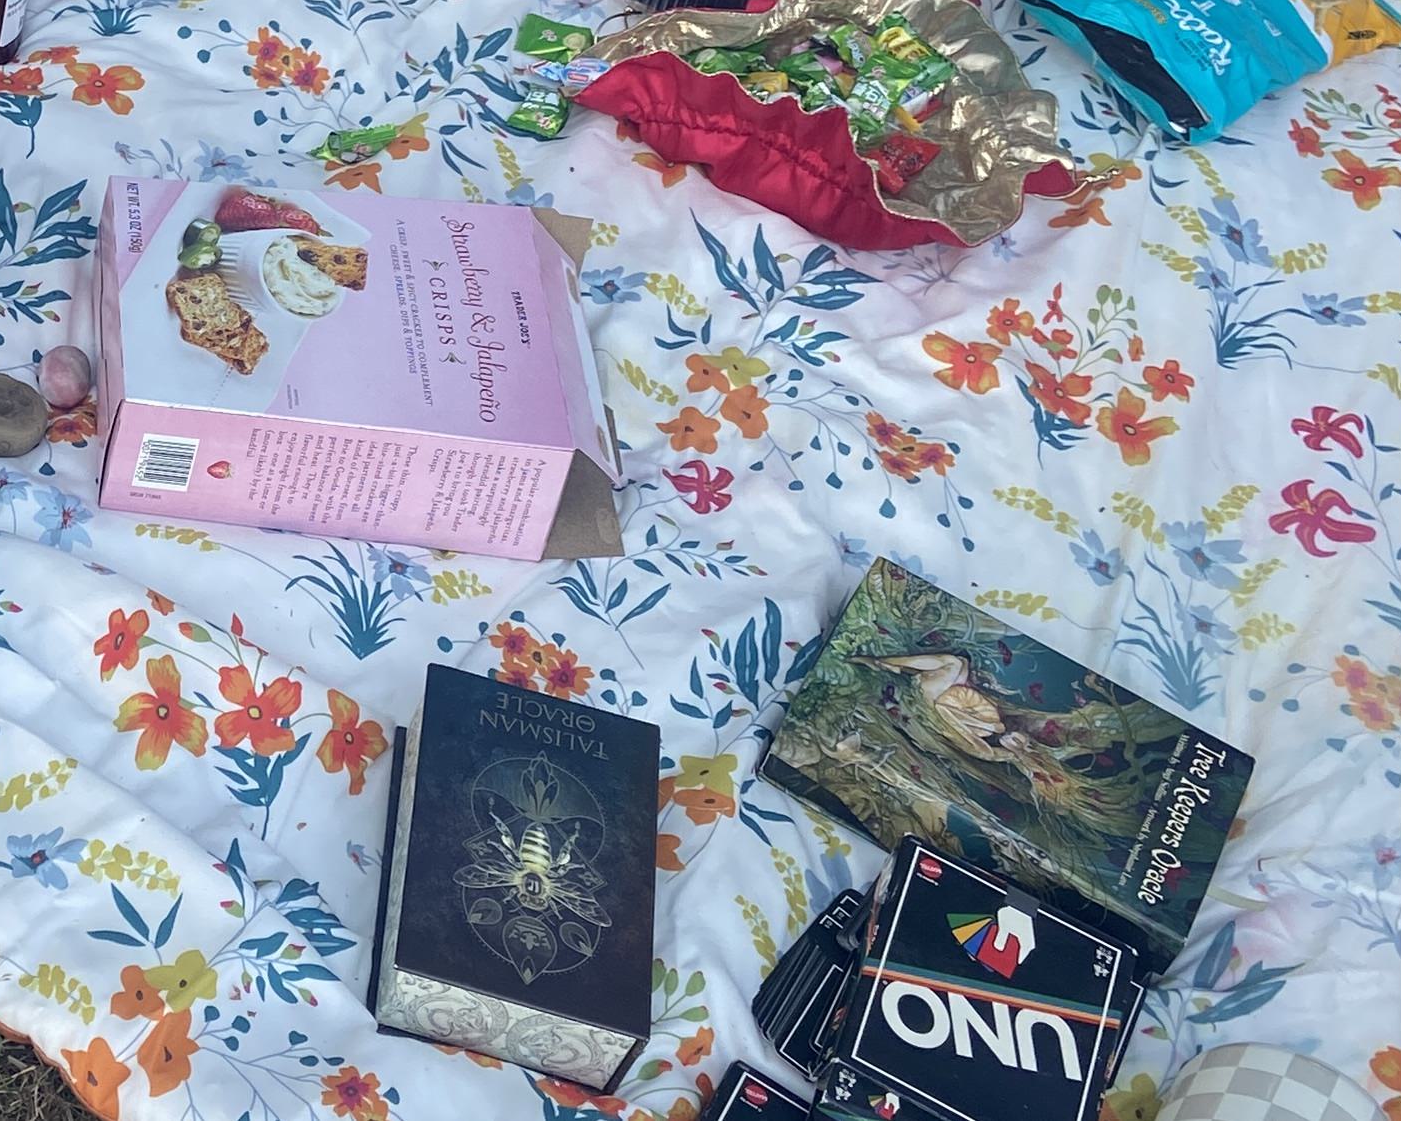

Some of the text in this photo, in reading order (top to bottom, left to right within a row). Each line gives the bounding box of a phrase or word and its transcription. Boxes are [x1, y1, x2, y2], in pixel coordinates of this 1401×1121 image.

[127, 183, 139, 195] NET
[129, 209, 141, 219] 5.3
[130, 221, 141, 230] OZ
[128, 232, 143, 253] (150g)
[400, 249, 411, 273] SWEET
[405, 281, 417, 303] SPICY
[429, 278, 456, 345] CRISPS
[510, 289, 527, 321] TRADER
[399, 309, 409, 326] DIPS
[409, 303, 422, 338] CRACKER
[441, 216, 507, 422] Strawberry & Jalapeño
[403, 335, 417, 374] TOPPINGS
[415, 339, 424, 350] TO
[417, 351, 432, 406] COMPLEMENT
[277, 431, 288, 444] box
[298, 434, 313, 465] flavorful
[315, 435, 324, 449] and
[341, 439, 352, 454] Brie
[353, 439, 365, 460] kinds
[271, 453, 279, 467] one
[325, 437, 337, 463] perfect
[367, 441, 377, 459] ideal
[405, 447, 418, 467] These
[271, 433, 297, 515] enjoy straight from the
[357, 461, 370, 492] partners
[437, 450, 457, 489] Strawberry
[466, 453, 481, 479] though
[479, 455, 493, 487] splendid
[496, 456, 505, 474] make
[519, 467, 529, 485] jams
[288, 467, 301, 494] enough
[302, 473, 316, 499] They're
[317, 465, 331, 492] balance
[529, 468, 542, 497] popular
[249, 489, 257, 500] the
[261, 483, 271, 499] time
[365, 481, 377, 510] crackers
[445, 481, 460, 501] bring
[460, 489, 469, 505] took
[487, 457, 519, 544] strawberry and jalapeño
[514, 487, 523, 502] and
[325, 496, 333, 511] with
[335, 503, 347, 520] from
[351, 503, 359, 512] all
[425, 498, 441, 531] Jalapeño
[443, 503, 451, 516] you
[477, 483, 497, 527] surprisingly
[321, 513, 330, 524] the
[451, 508, 466, 532] Trader
[513, 499, 532, 546] combination
[496, 691, 596, 733] ORACLE
[480, 709, 609, 760] TALISMAN
[1166, 755, 1180, 766] by
[1138, 742, 1226, 903] Tree Keepers Oracle
[1140, 807, 1159, 834] Artwork
[1134, 830, 1148, 842] by
[882, 981, 1082, 1082] UNO
